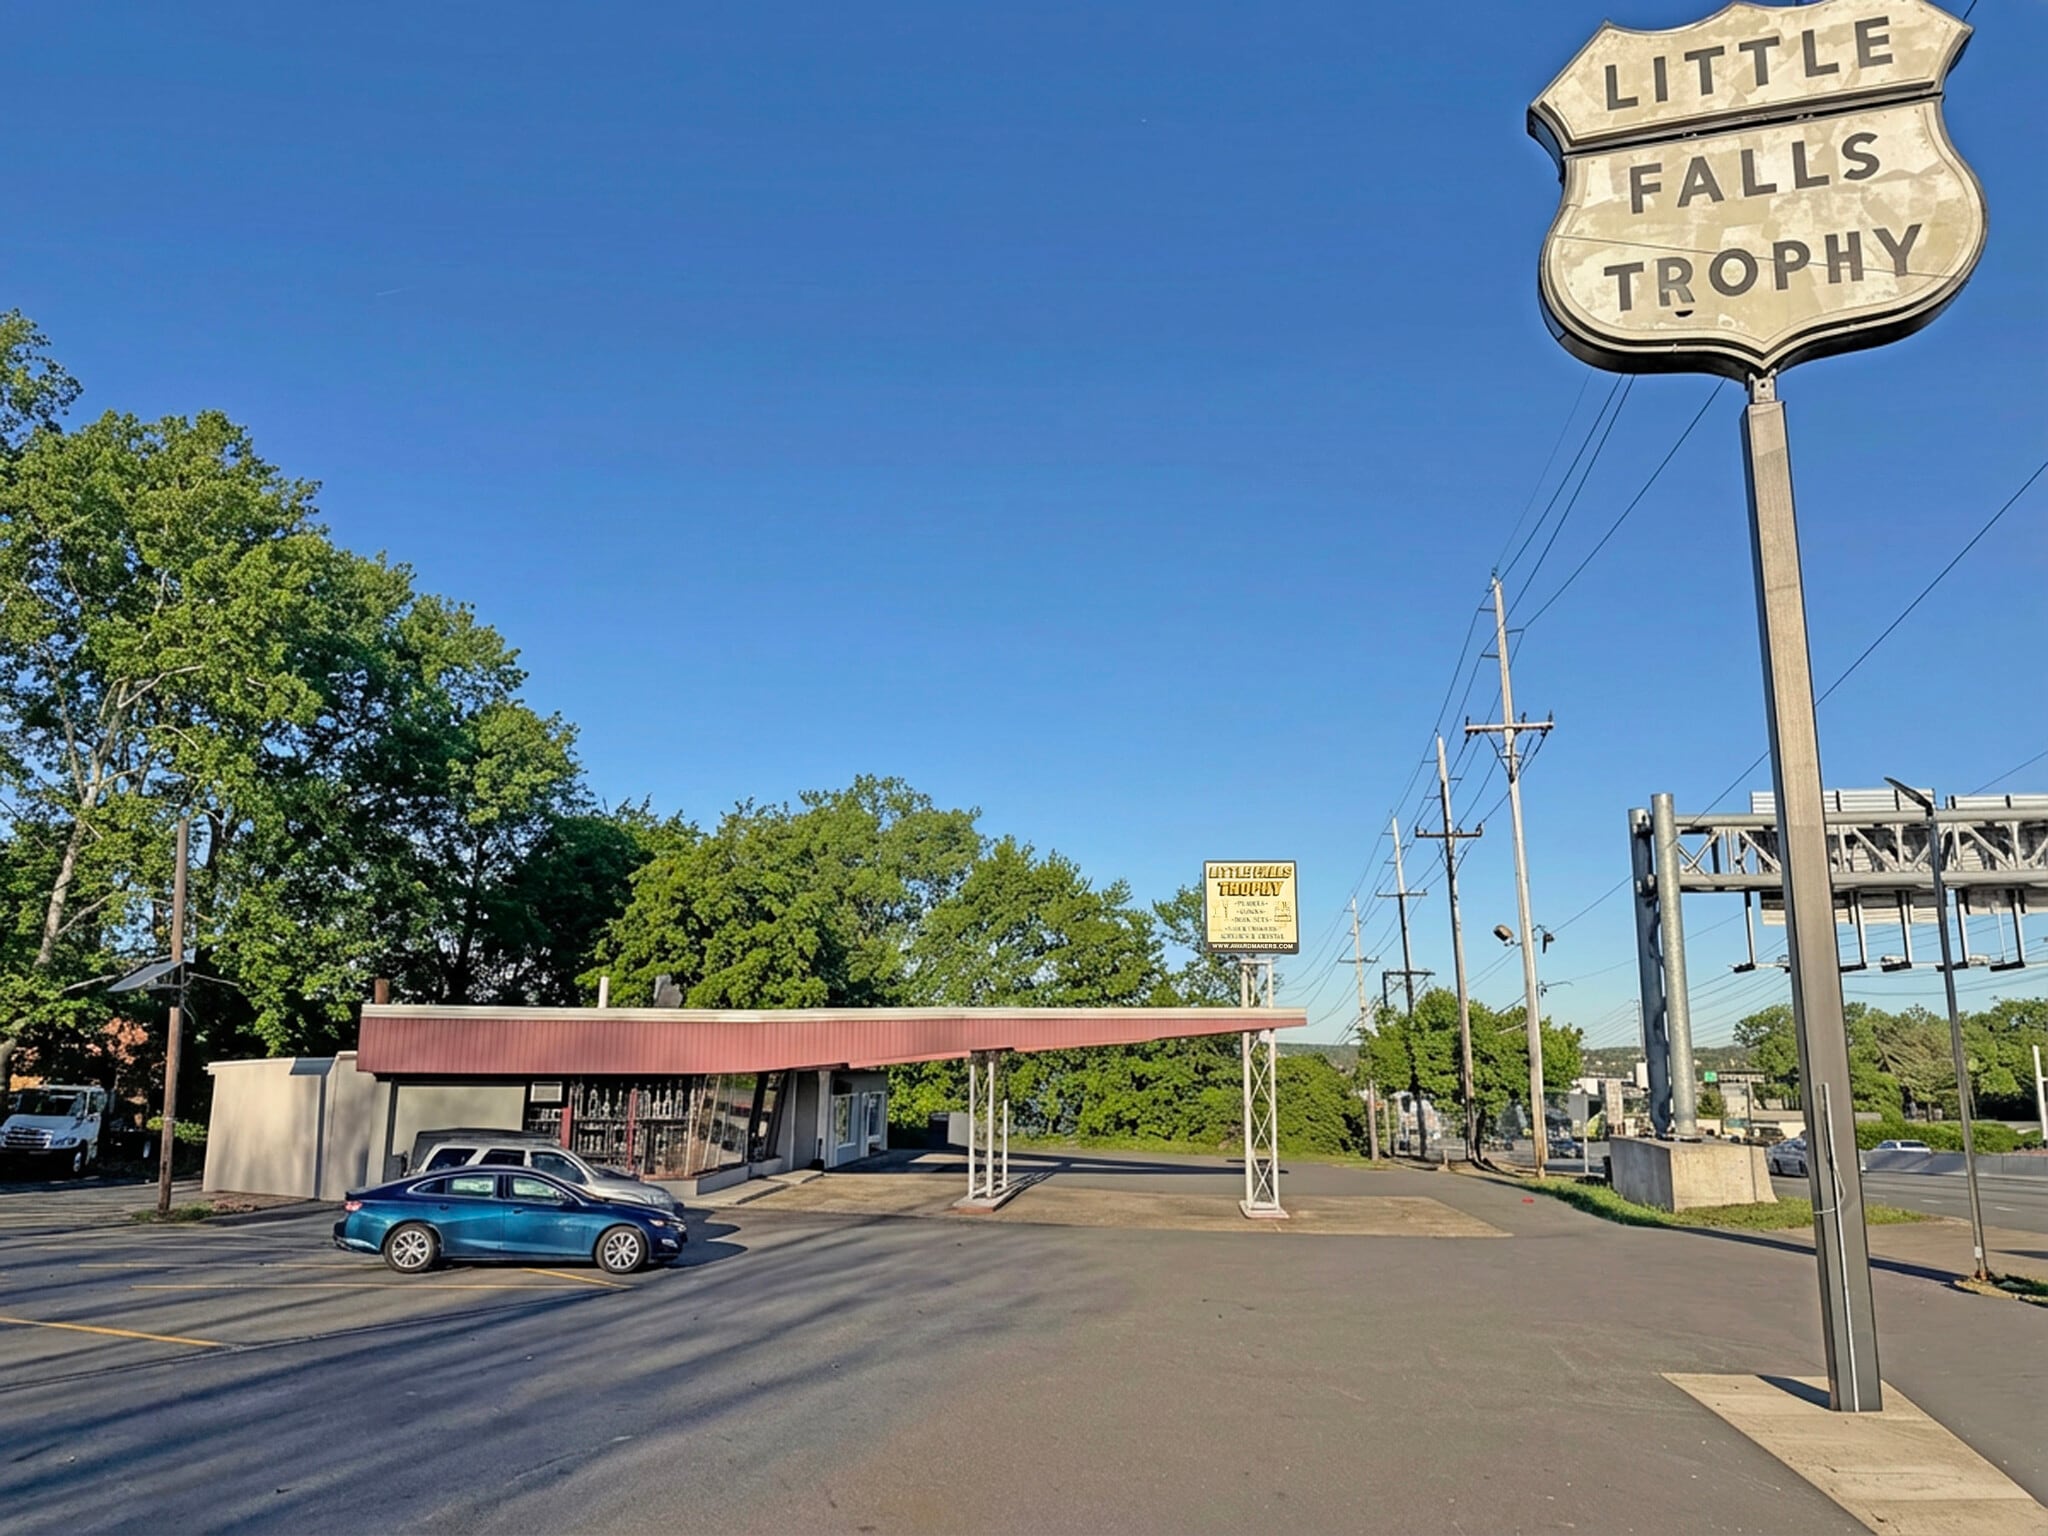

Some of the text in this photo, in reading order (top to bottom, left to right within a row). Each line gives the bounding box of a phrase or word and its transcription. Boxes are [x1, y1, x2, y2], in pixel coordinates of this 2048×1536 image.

[1604, 16, 1893, 111] LITTLE
[1629, 132, 1881, 214] FALLS
[1604, 223, 1923, 311] TROPHY
[1208, 865, 1292, 879] LITTLE FALLS
[1217, 880, 1284, 897] TROPHY
